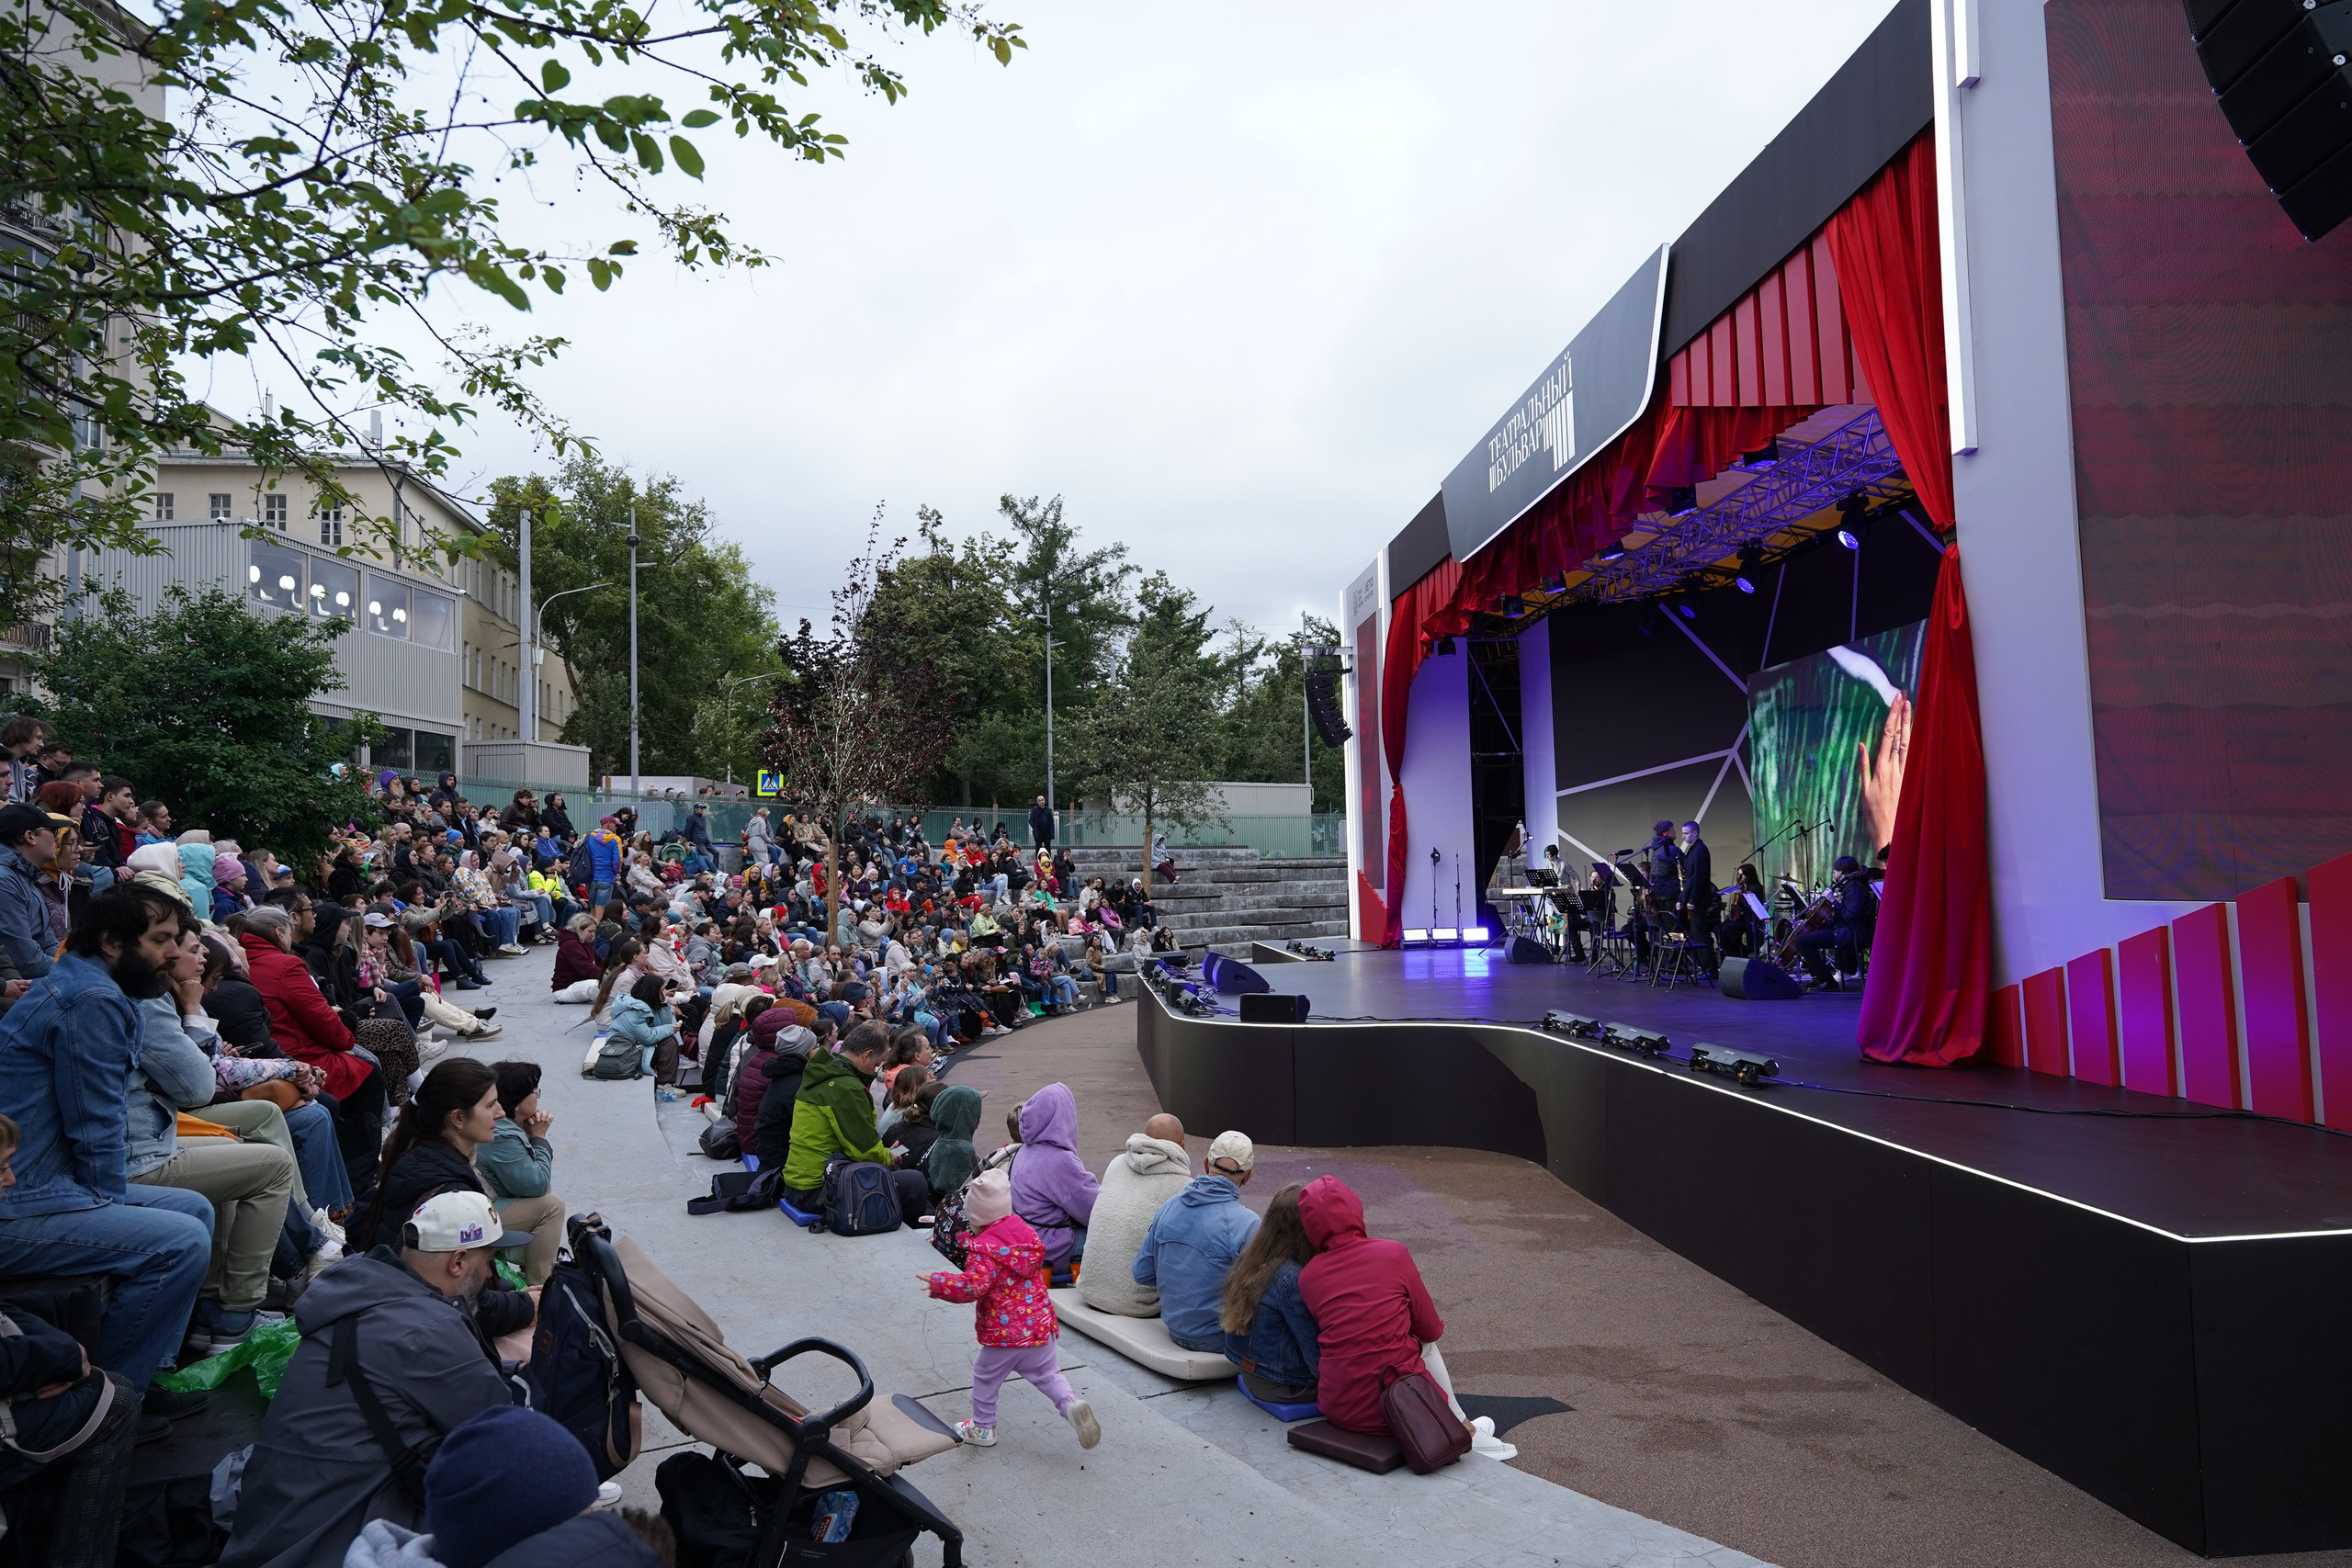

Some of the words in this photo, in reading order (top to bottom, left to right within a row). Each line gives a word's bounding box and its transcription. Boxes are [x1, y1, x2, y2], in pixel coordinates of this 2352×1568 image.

[1488, 350, 1573, 463] ТЕАТРАЛЬНЫЙ
[1496, 418, 1544, 487] БУЛЬВАР
[675, 1357, 693, 1371] Bravo
